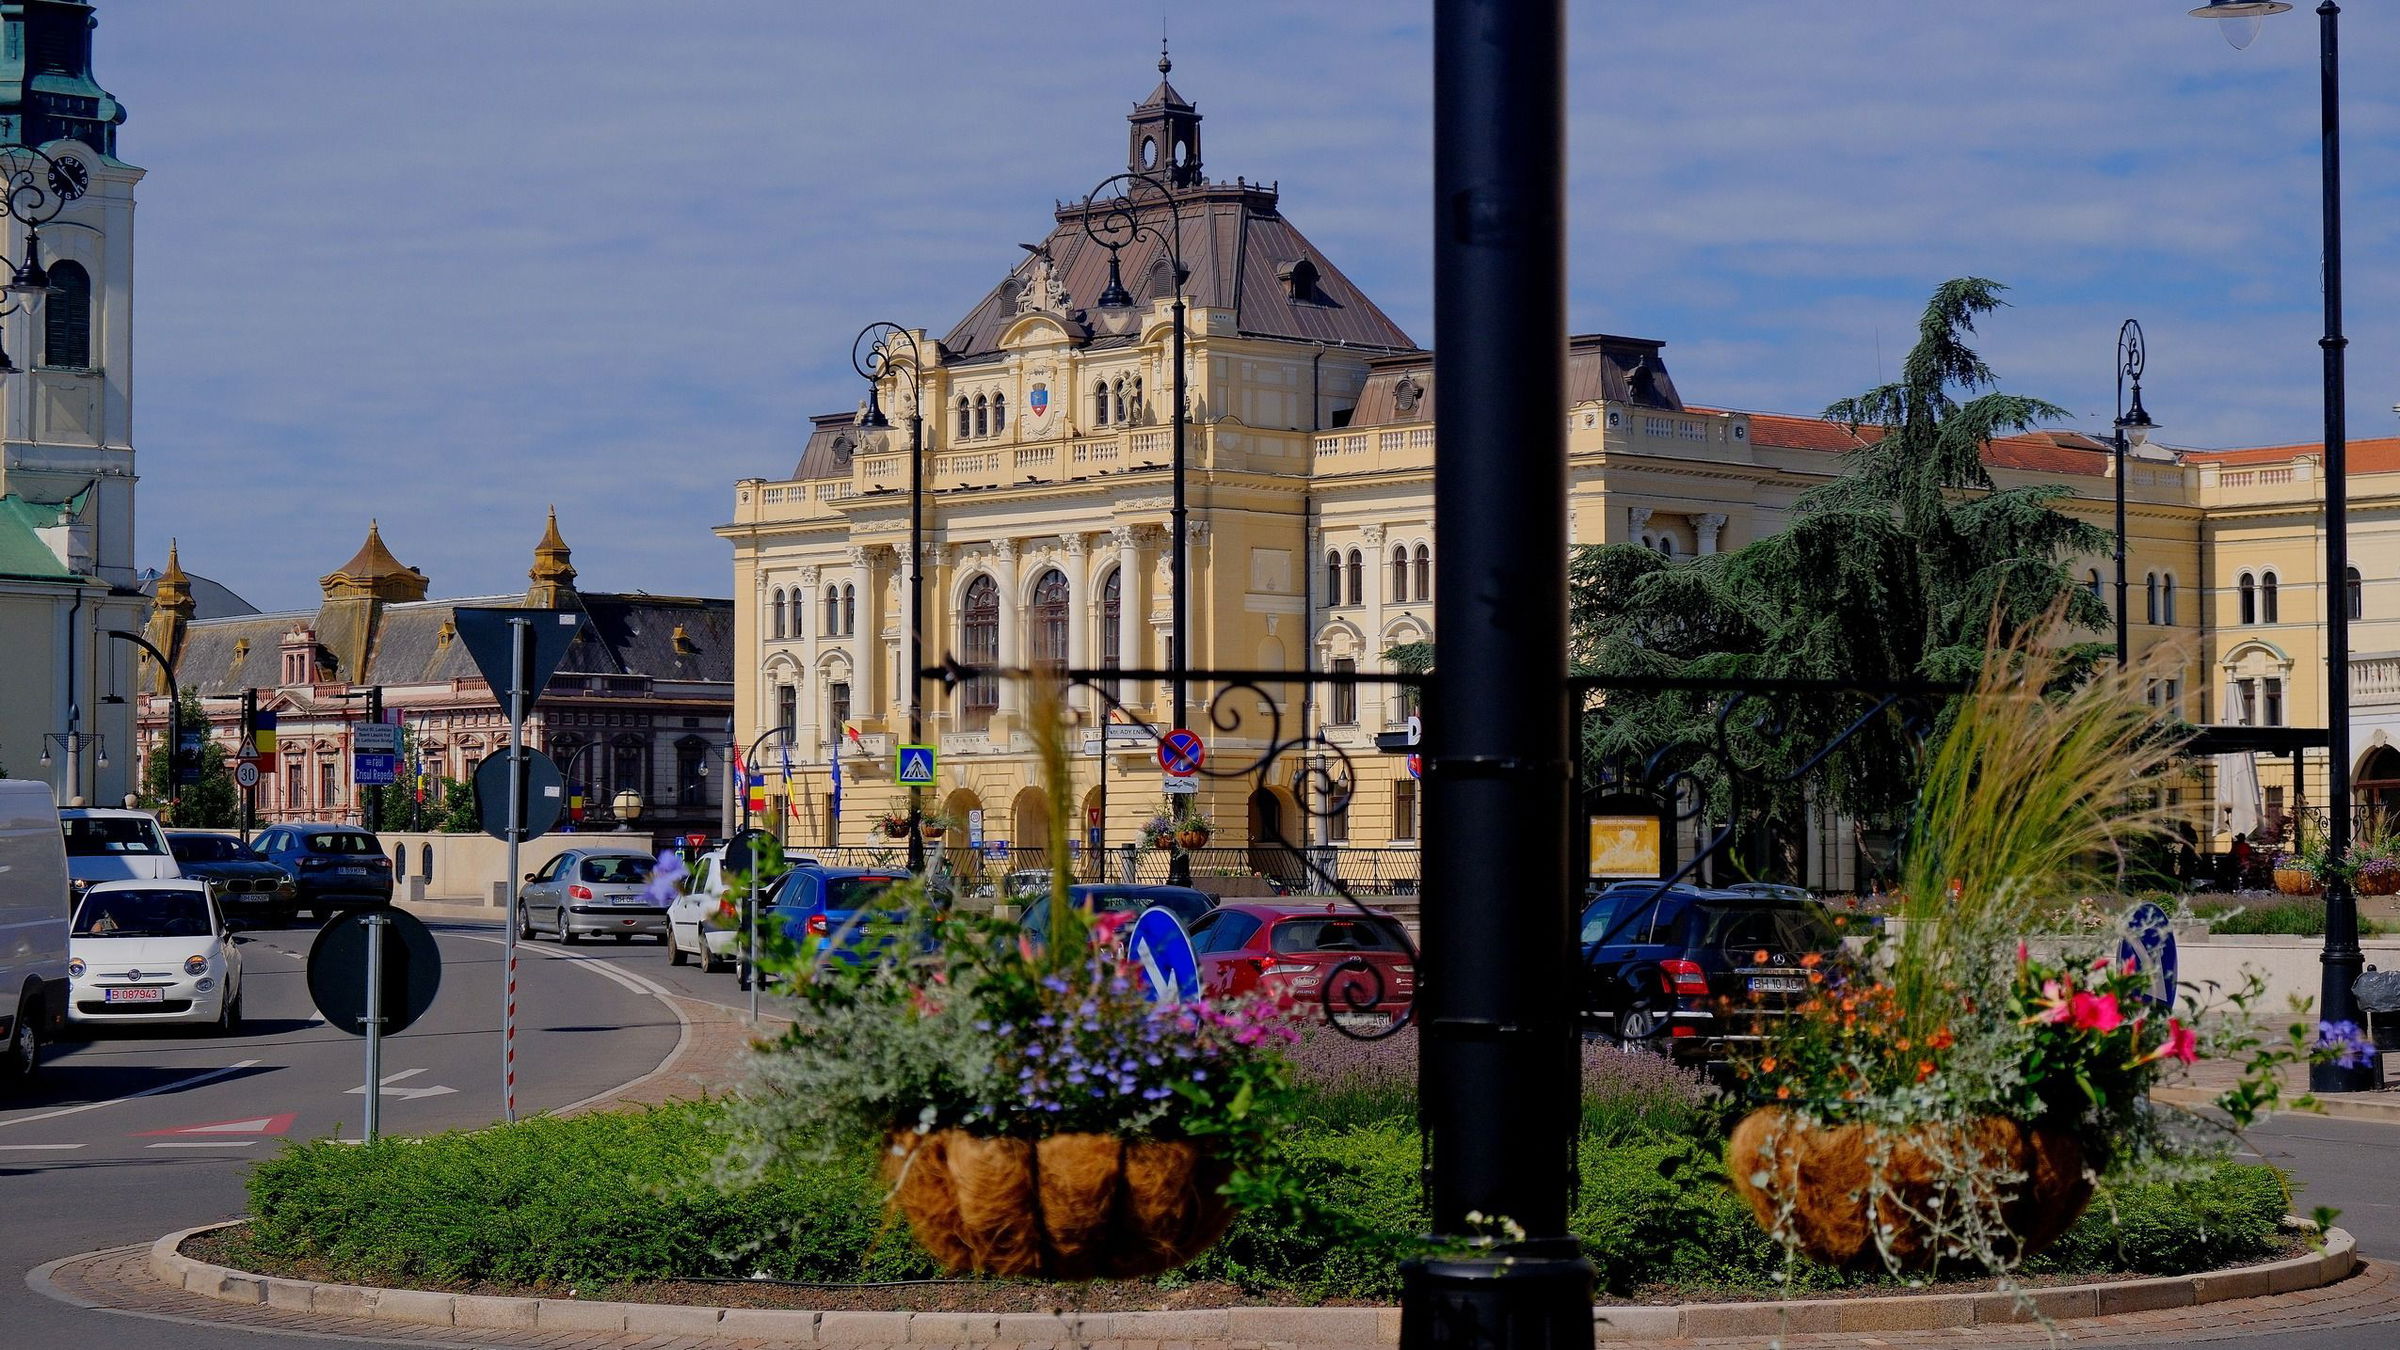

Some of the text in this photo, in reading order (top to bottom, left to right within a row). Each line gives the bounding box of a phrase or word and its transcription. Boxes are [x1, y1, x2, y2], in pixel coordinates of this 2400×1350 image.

[65, 157, 73, 165] 12
[48, 172, 55, 180] 9
[81, 176, 87, 184] 3
[241, 768, 255, 781] 30
[372, 768, 394, 783] Repede
[1754, 978, 1769, 989] BH
[1772, 978, 1782, 989] 10
[112, 989, 157, 999] B 087943
